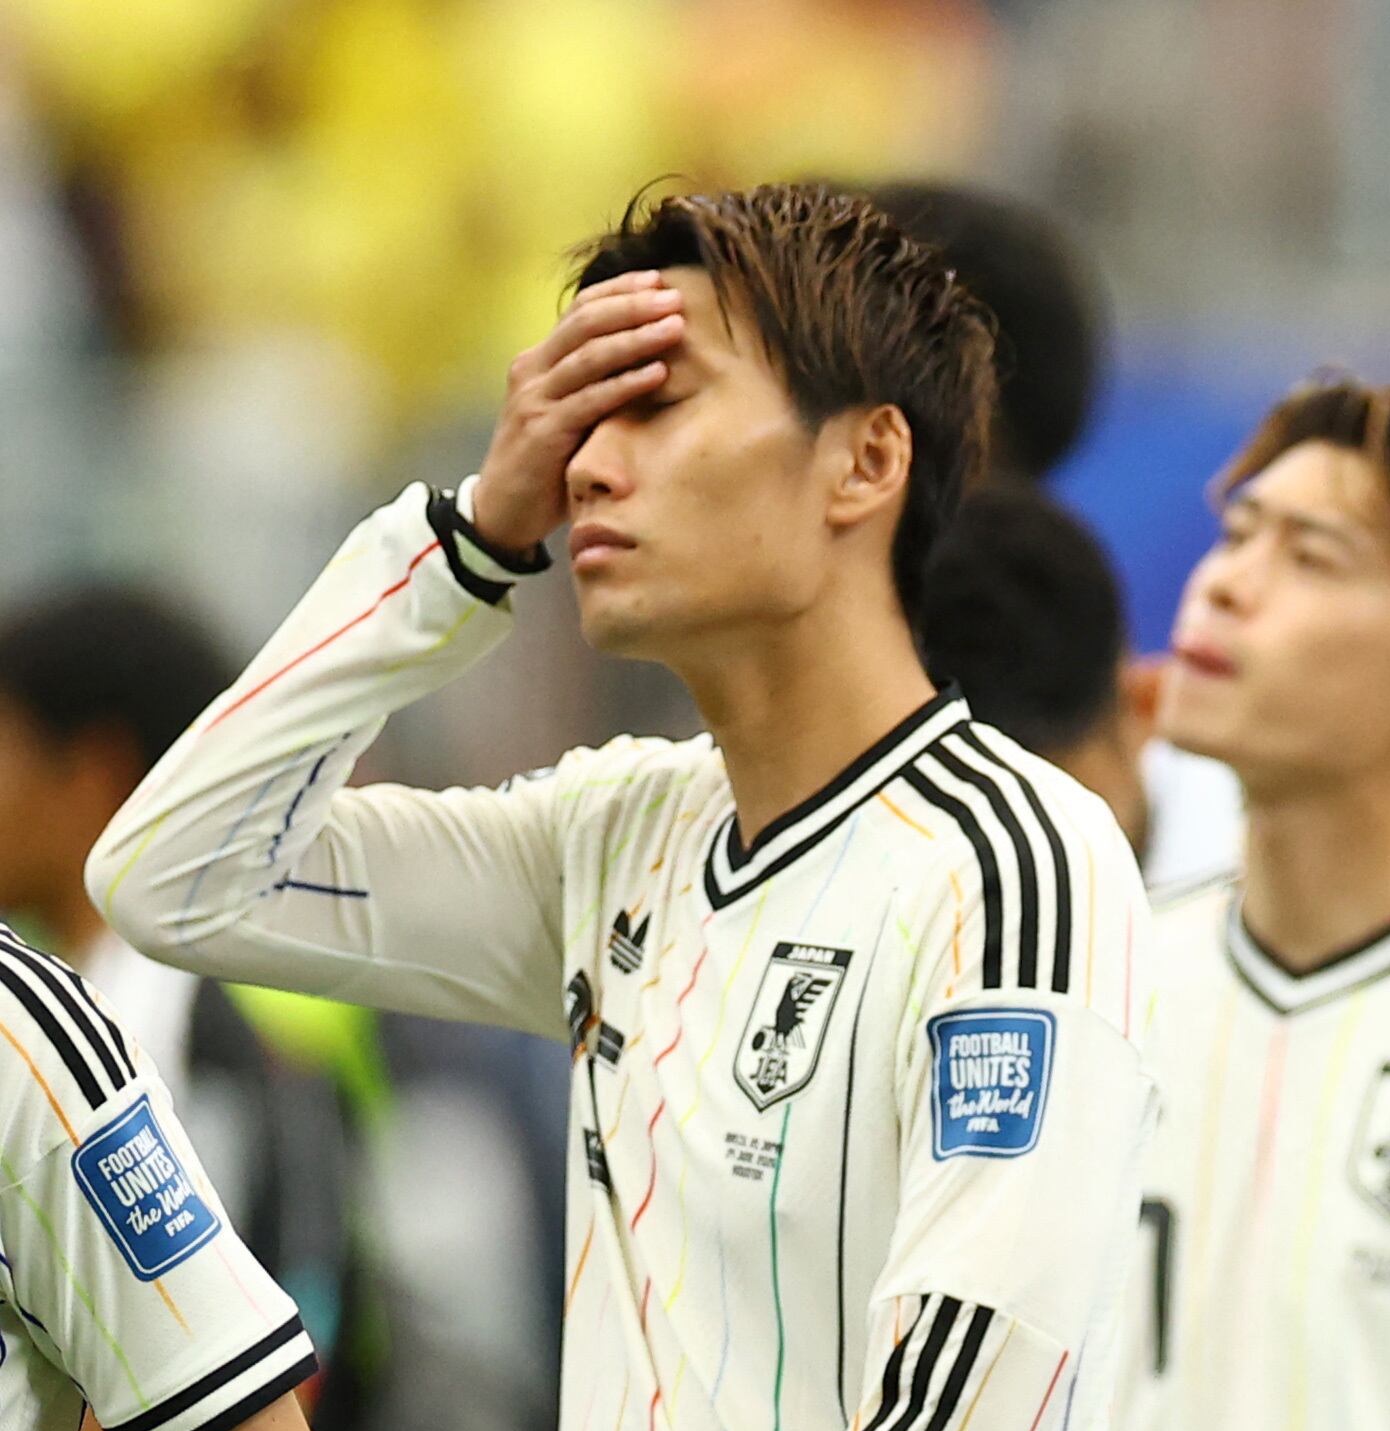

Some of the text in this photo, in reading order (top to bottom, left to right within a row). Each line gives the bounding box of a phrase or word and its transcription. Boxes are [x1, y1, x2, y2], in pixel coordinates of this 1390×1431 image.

[950, 1032, 1031, 1057] FOOTBALL
[950, 1056, 1031, 1089] UNITES
[947, 1088, 1034, 1119] the World
[966, 1117, 1000, 1132] FIFA
[98, 1125, 158, 1180] FOOTBALL
[111, 1145, 175, 1207] UNITES
[126, 1205, 161, 1235] the
[165, 1210, 195, 1237] FIFA
